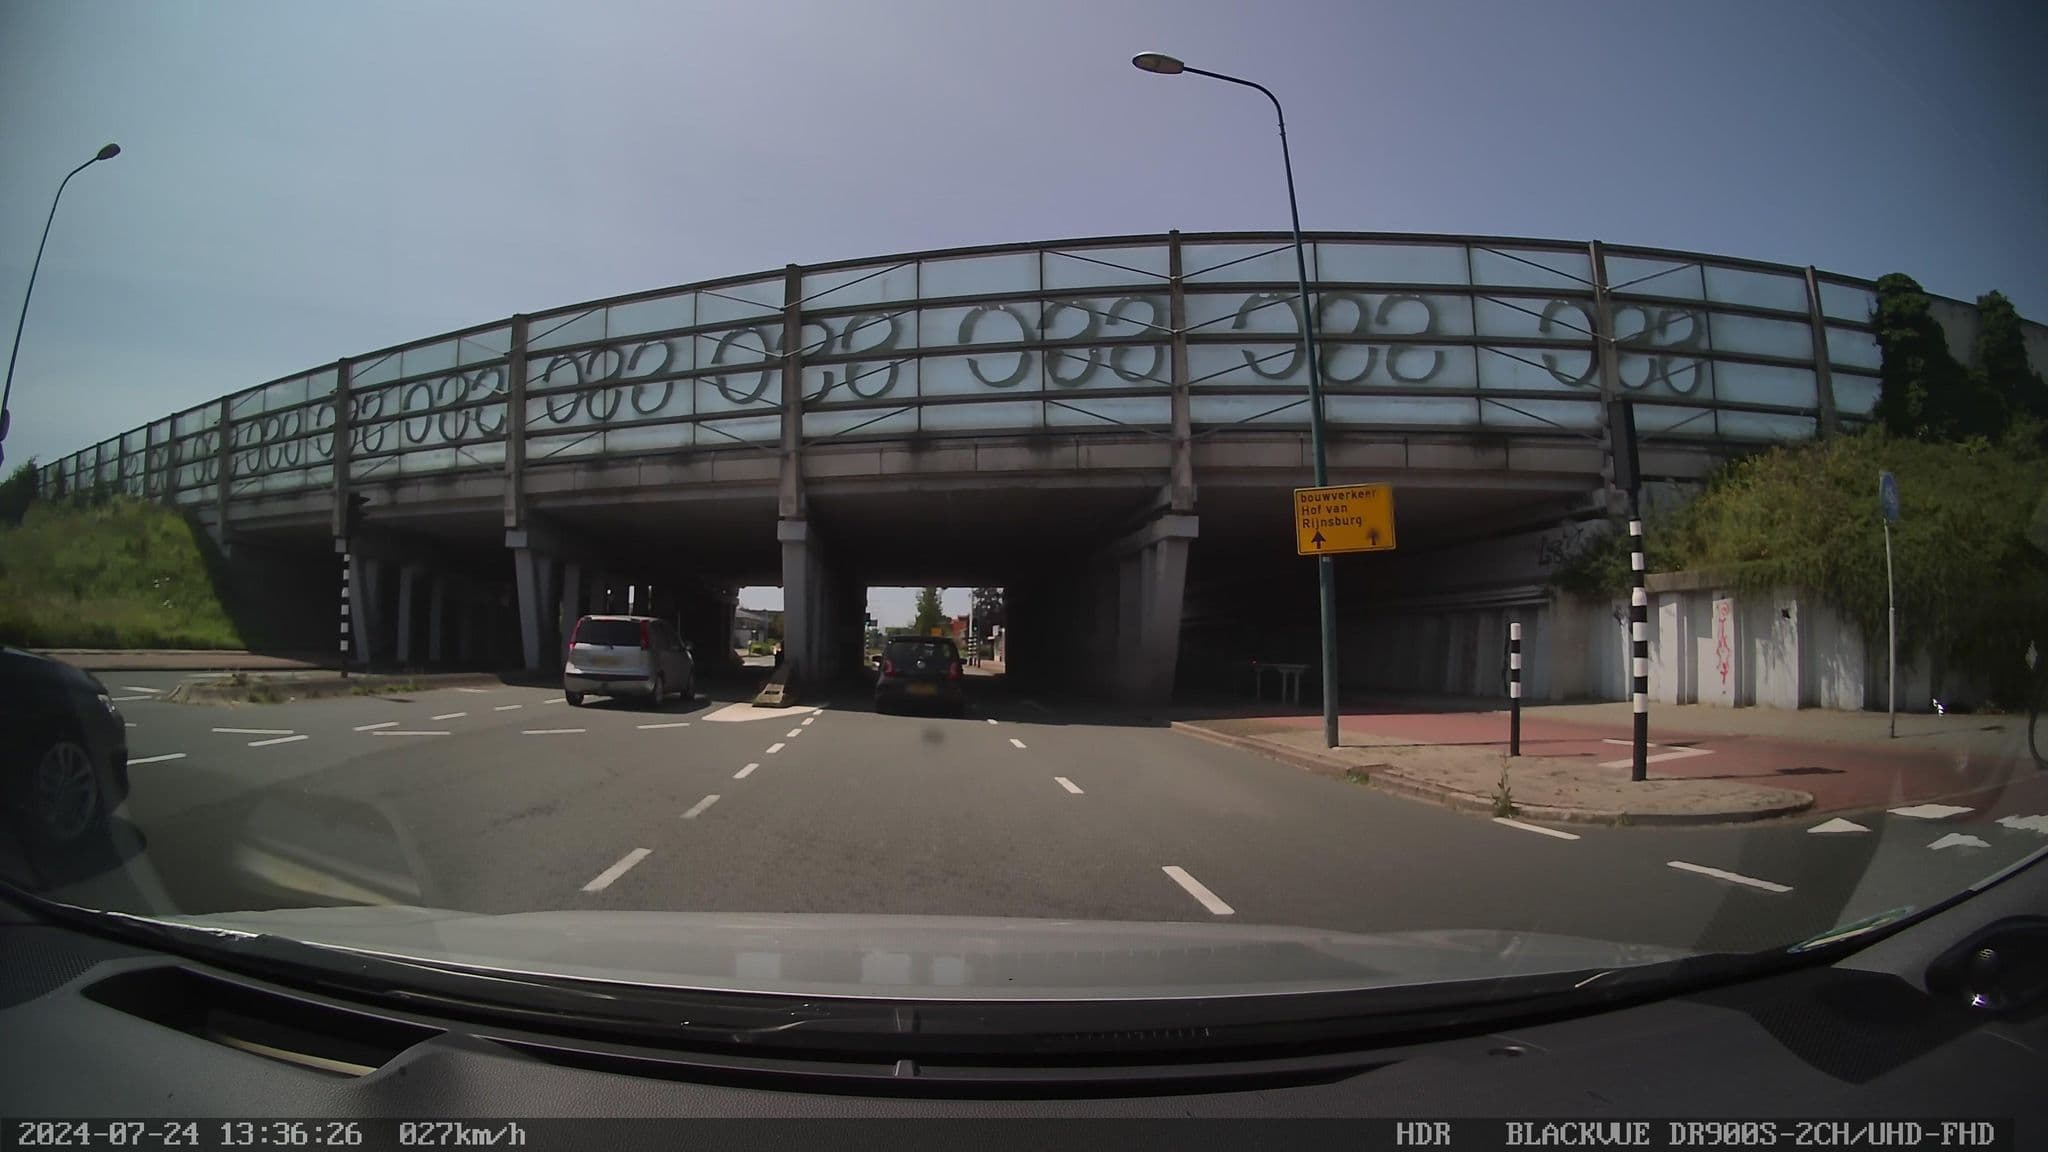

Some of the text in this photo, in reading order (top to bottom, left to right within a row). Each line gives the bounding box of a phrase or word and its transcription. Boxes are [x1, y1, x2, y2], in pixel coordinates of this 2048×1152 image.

[1301, 488, 1377, 503] bouwverkeer
[1302, 504, 1348, 515] Hof van
[1302, 516, 1363, 530] Rijnsburg
